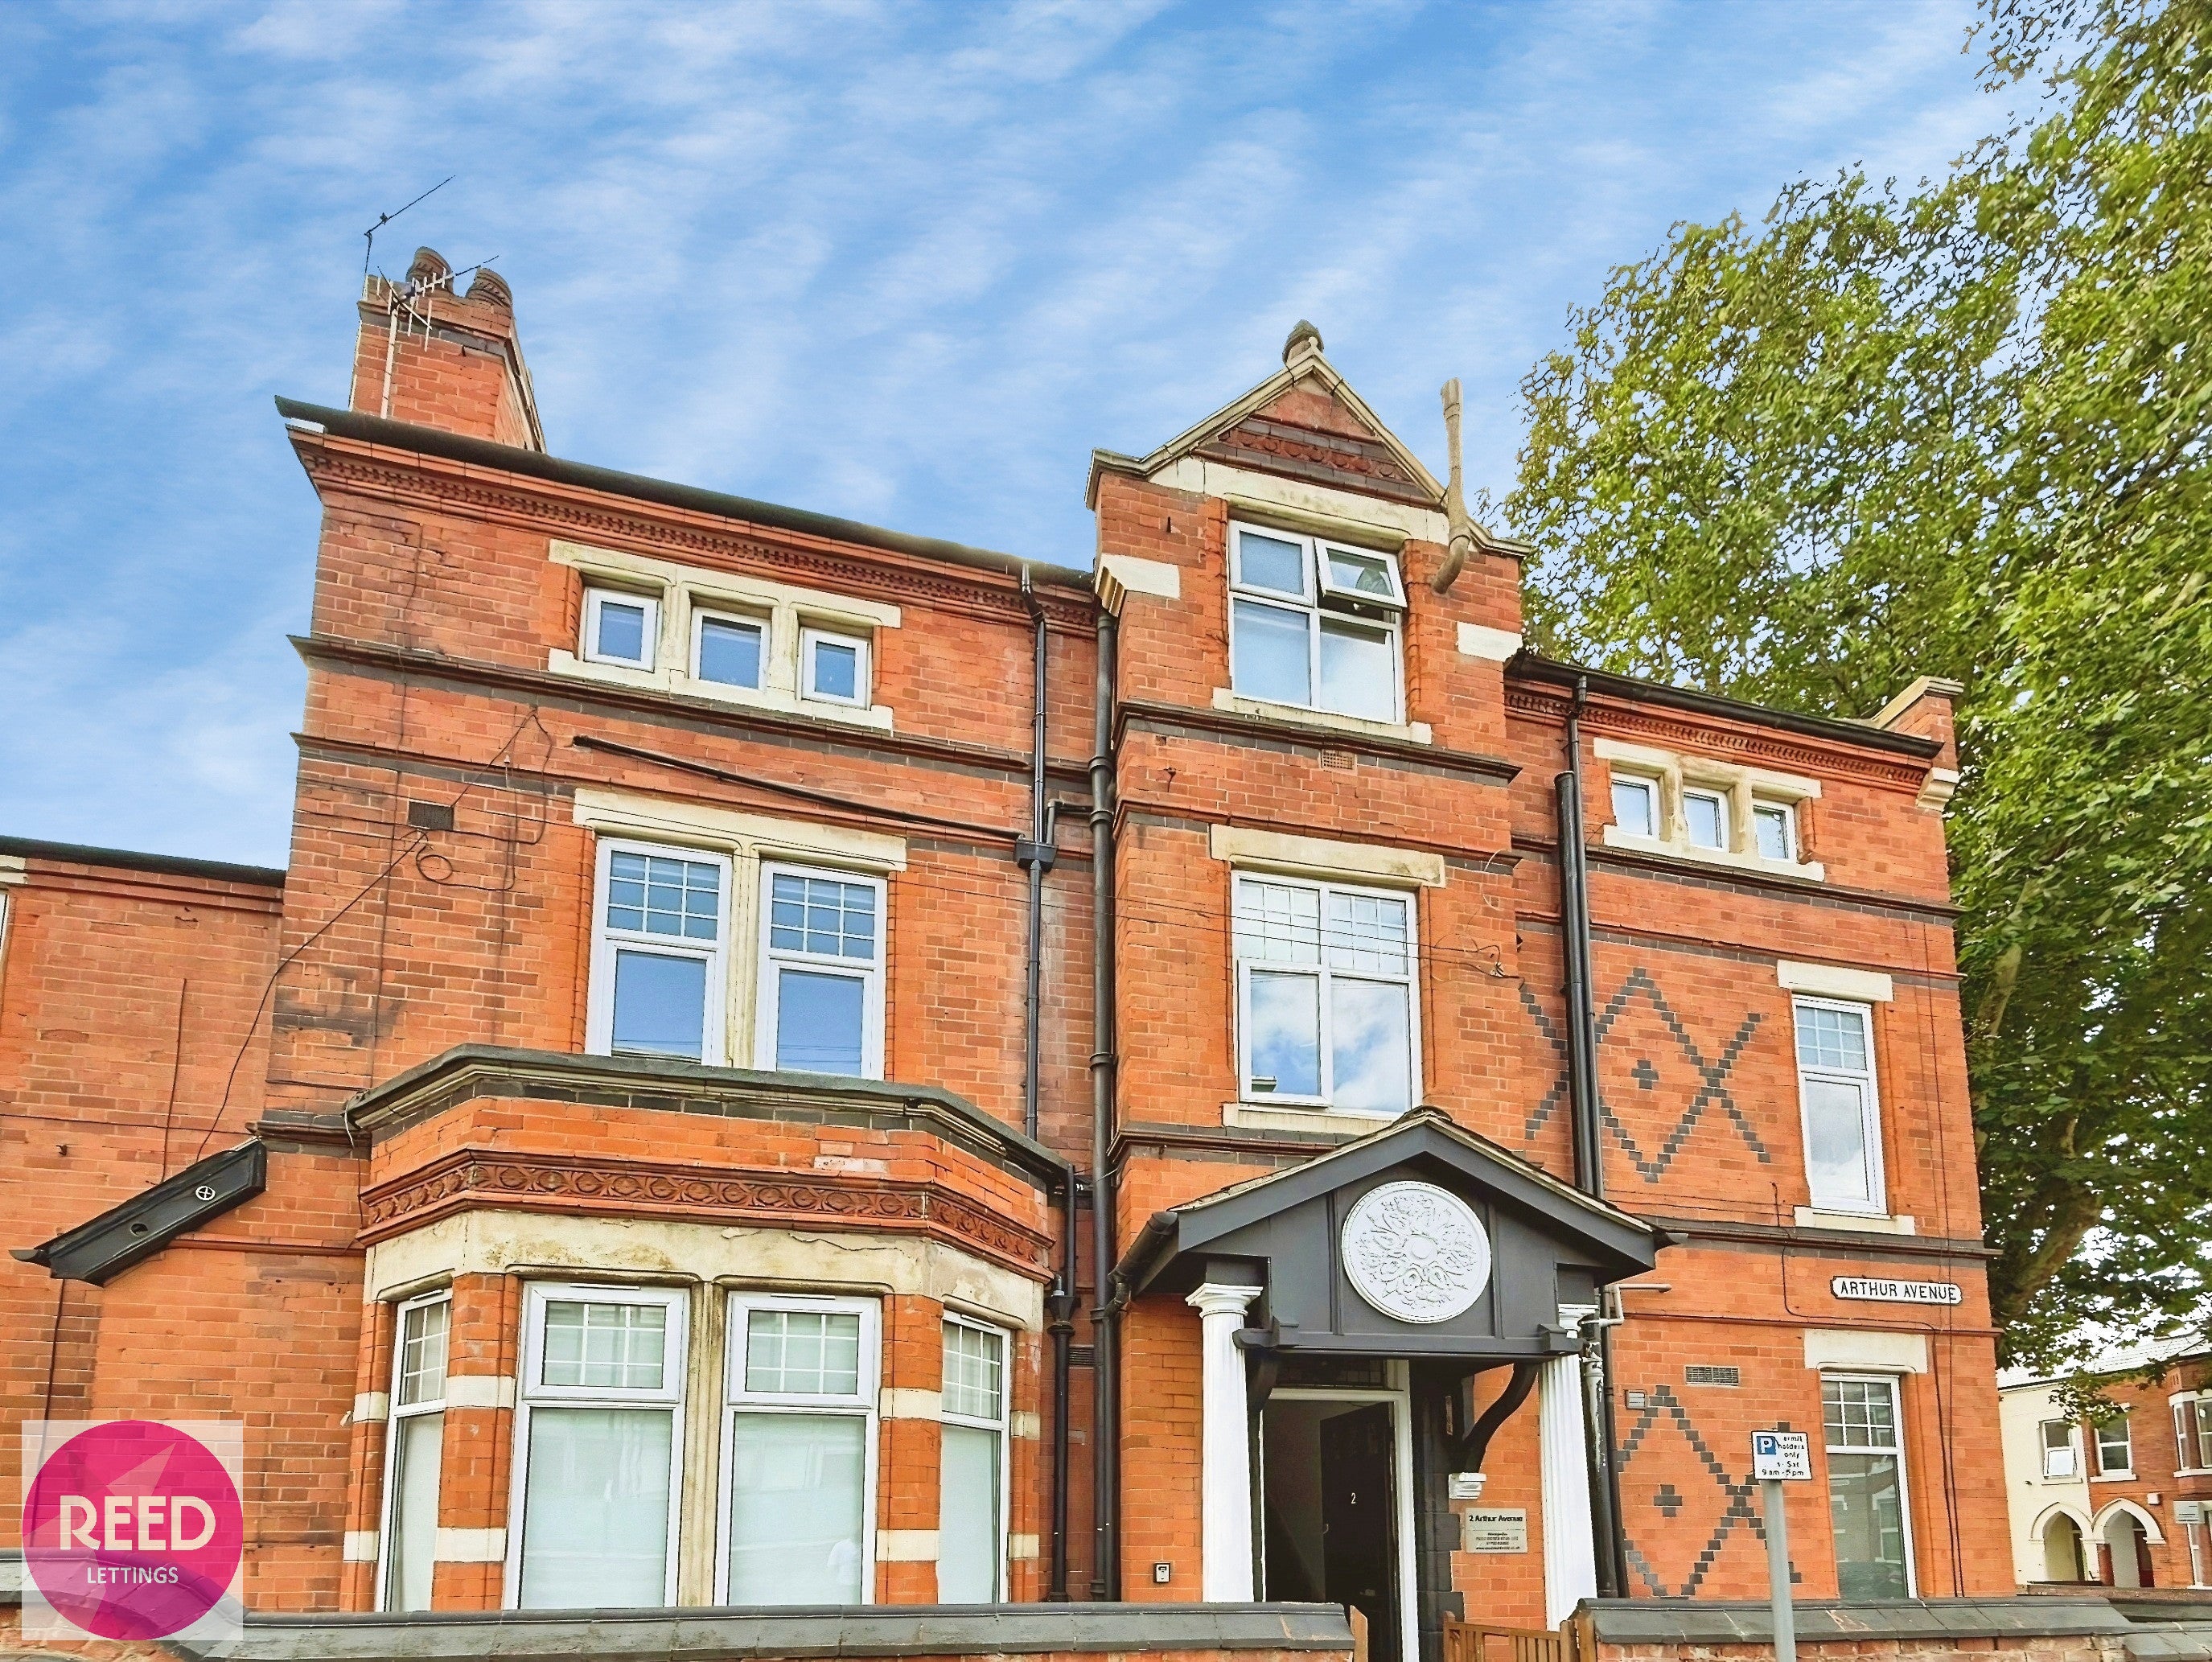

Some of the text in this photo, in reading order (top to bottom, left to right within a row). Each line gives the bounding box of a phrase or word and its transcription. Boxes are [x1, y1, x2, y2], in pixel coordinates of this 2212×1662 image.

[1840, 1280, 1957, 1301] ARTHUR AVENUE
[1760, 1437, 1773, 1454] P
[1783, 1451, 1800, 1459] only
[1786, 1460, 1800, 1468] Sat
[1351, 1492, 1356, 1504] 2
